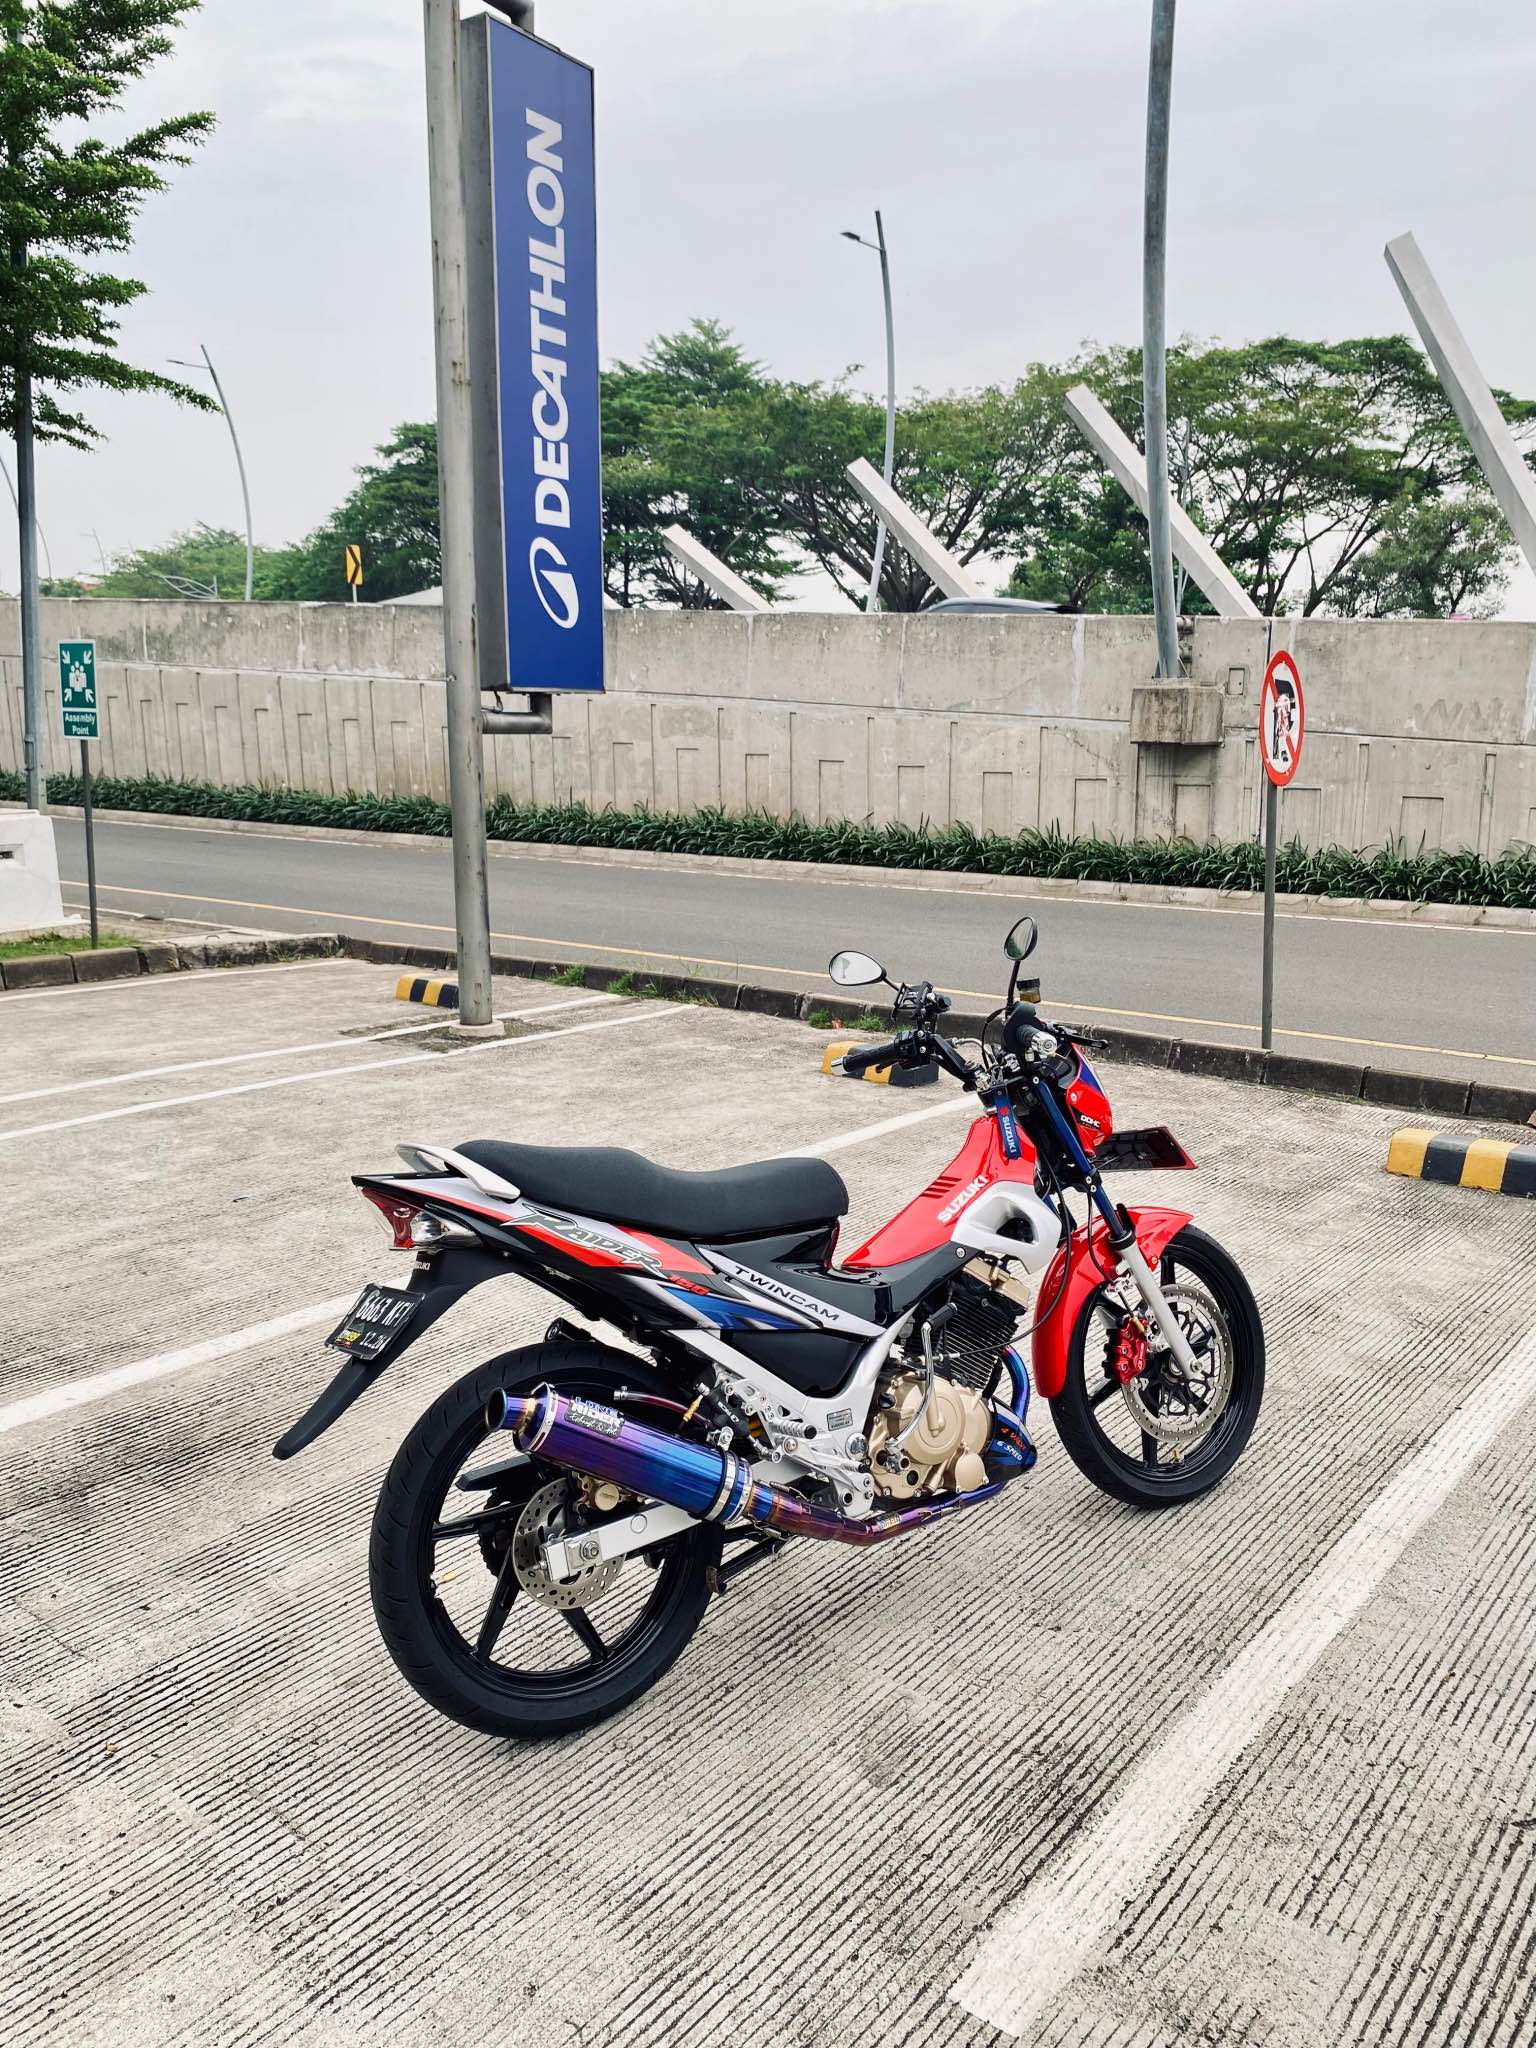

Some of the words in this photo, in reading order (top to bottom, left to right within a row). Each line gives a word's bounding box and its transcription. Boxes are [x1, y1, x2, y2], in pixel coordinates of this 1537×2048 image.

[525, 107, 571, 528] DECATHLON
[65, 712, 96, 725] Assembly
[72, 725, 89, 735] Point
[1001, 1115, 1017, 1154] SUZUKI
[1080, 1114, 1100, 1128] DOHC
[937, 1174, 990, 1224] SUZUKI
[503, 1203, 667, 1278] RAIDER
[355, 1295, 393, 1323] 6663
[735, 1265, 840, 1321] TWINCAM
[1004, 1444, 1023, 1461] SPEED
